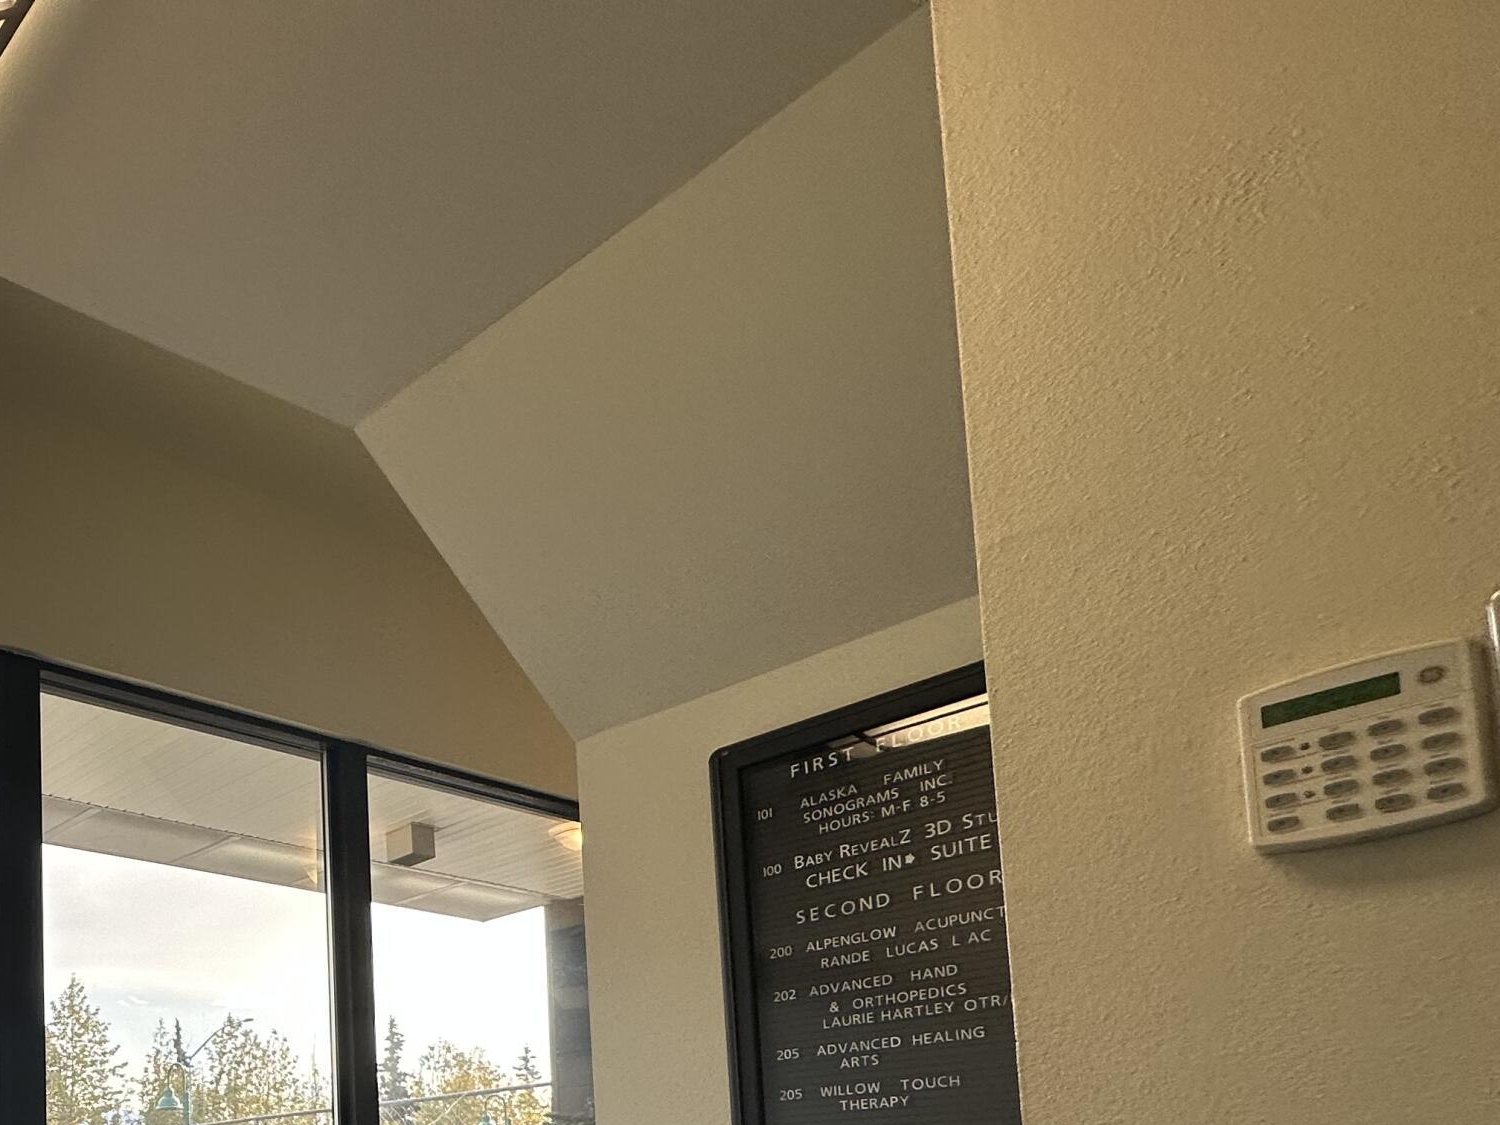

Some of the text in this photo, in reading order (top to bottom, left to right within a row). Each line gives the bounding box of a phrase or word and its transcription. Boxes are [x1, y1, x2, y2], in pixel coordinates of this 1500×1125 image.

[790, 717, 962, 779] FIRST FLOOR
[800, 759, 944, 809] ALASKA FAMILY
[757, 808, 773, 821] 101
[803, 788, 899, 824] SONOGRAMS
[881, 800, 911, 818] M-F
[920, 791, 946, 808] 8-5
[763, 863, 782, 878] 100
[794, 851, 833, 870] BABY
[925, 819, 952, 839] 3D
[806, 833, 993, 888] CHECK IN SUITE
[796, 869, 1002, 925] SECOND FLOOR
[769, 945, 793, 960] 200
[806, 926, 897, 953] ALPENGLOW
[820, 929, 992, 969] RANDE LUCAS L AC
[773, 964, 958, 1003] 202 ADVANCED HAND
[829, 983, 967, 1013] & ORTHOPEDICS
[823, 1012, 875, 1030] LAURIE
[881, 1001, 954, 1022] HARTLEY
[776, 1026, 986, 1062] 205 ADVANCED HEALING
[840, 1054, 879, 1070] ARTS
[780, 1075, 961, 1101] 205 WILLOW TOUCH
[840, 1095, 910, 1111] THERAPY
